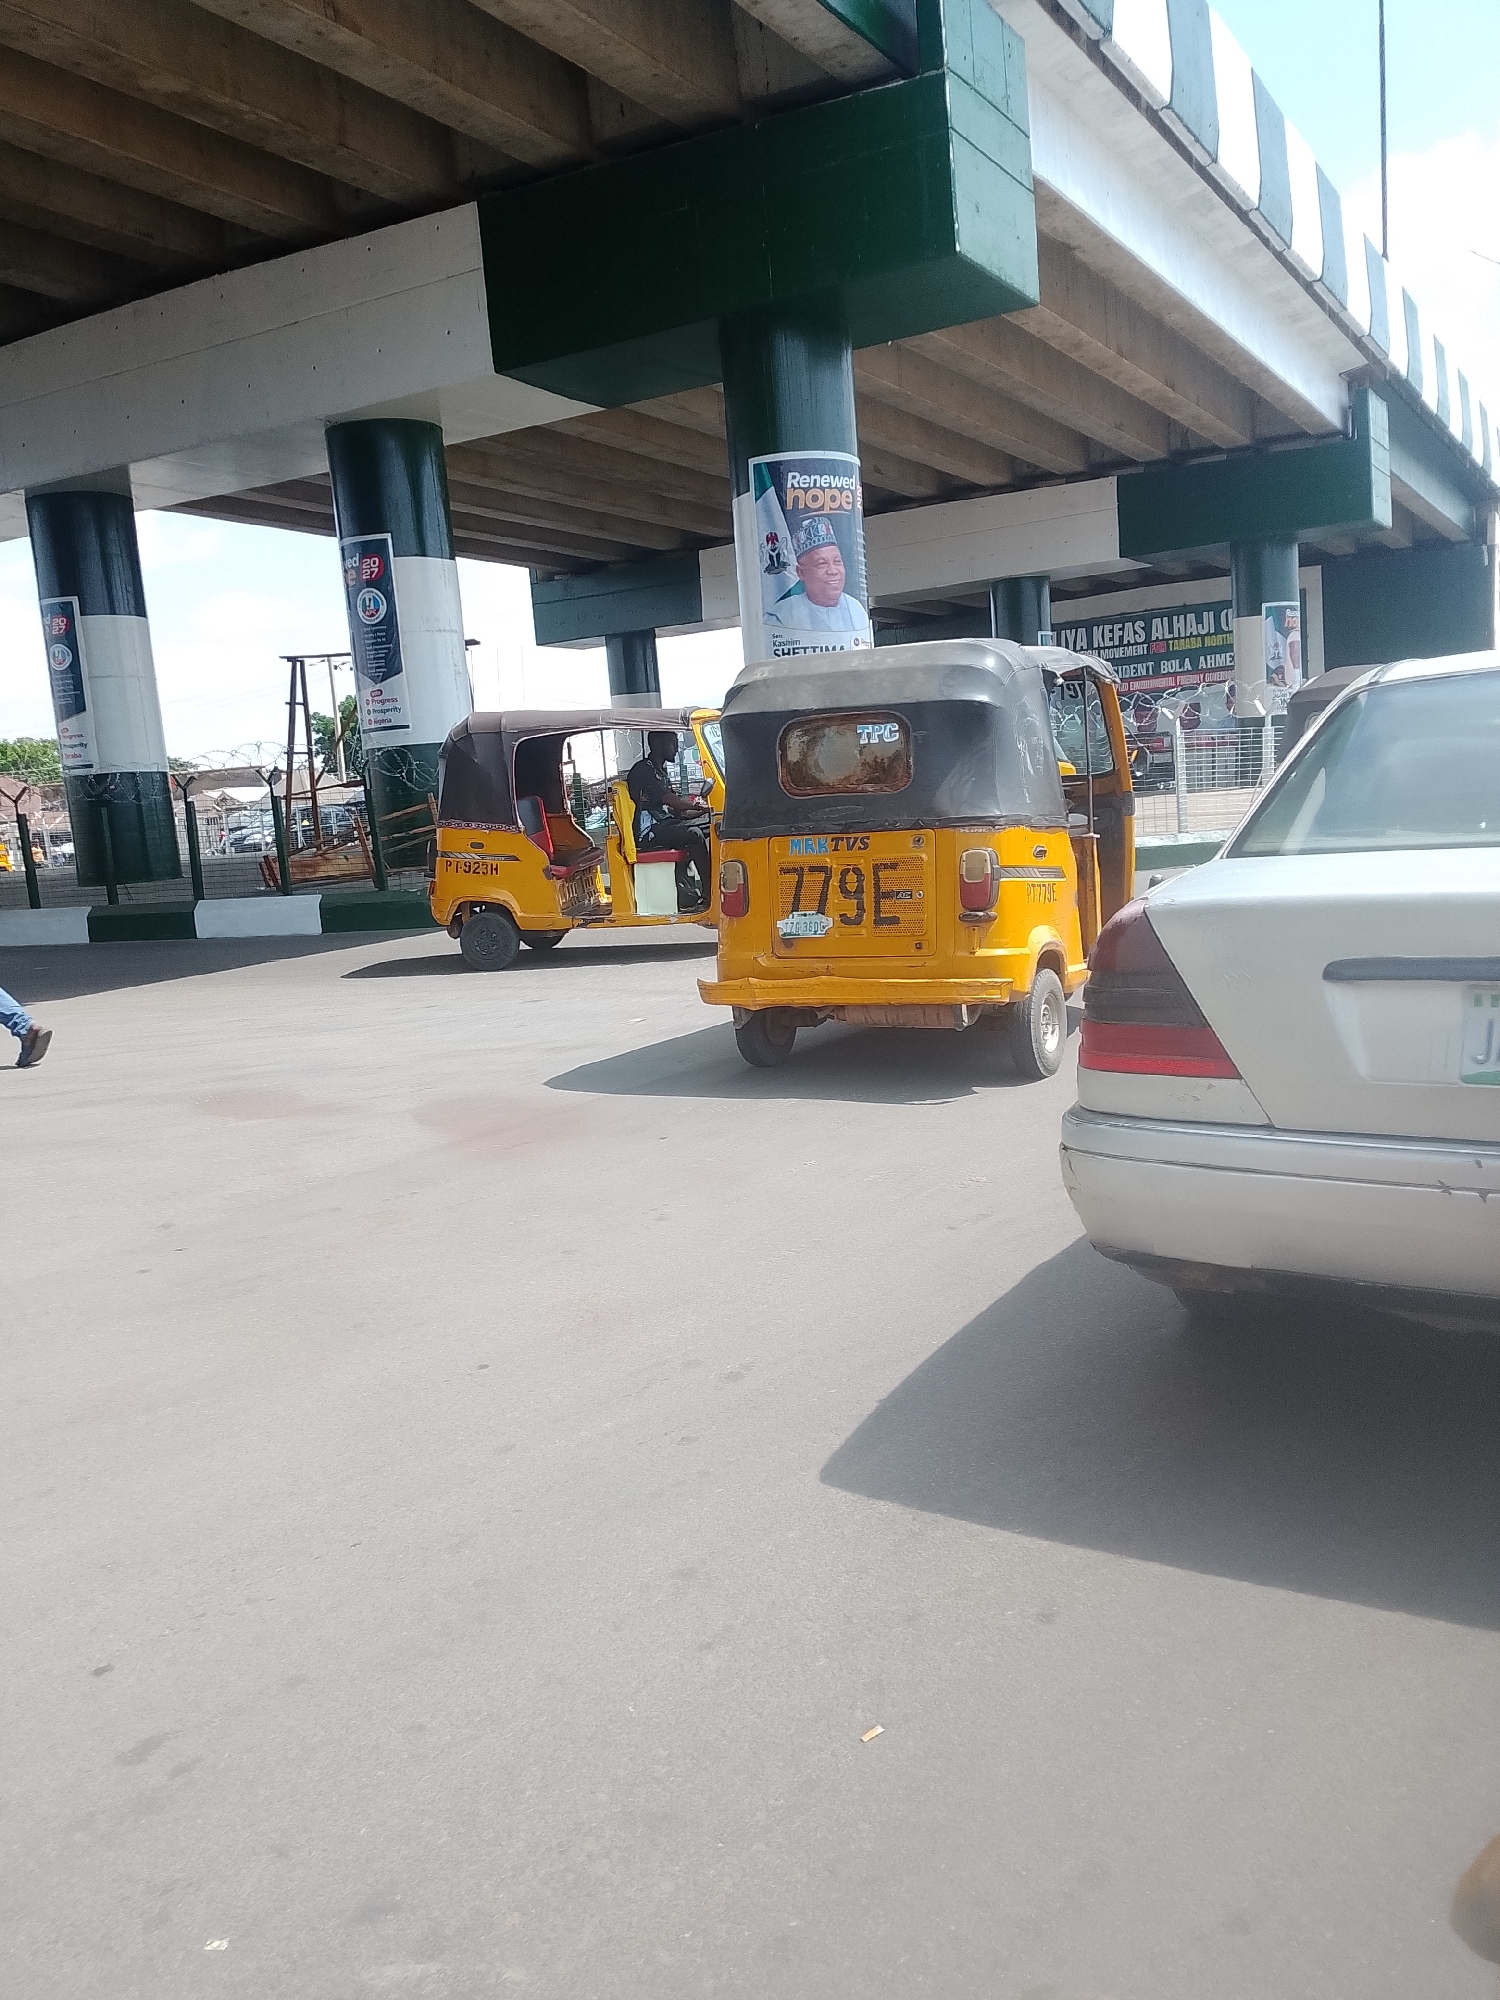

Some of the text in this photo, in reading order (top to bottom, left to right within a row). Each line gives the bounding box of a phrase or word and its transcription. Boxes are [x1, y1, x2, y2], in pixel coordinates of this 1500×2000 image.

[786, 471, 856, 490] Renewed
[362, 557, 380, 569] 20
[362, 567, 379, 580] 27
[52, 617, 67, 626] 20
[52, 625, 66, 635] 27
[1092, 620, 1146, 649] KEFAS
[1151, 610, 1216, 641] ALHAJI
[772, 638, 801, 648] Kashim
[1101, 643, 1148, 660] MOVEMENT
[1160, 657, 1192, 674] BOLA
[371, 697, 399, 706] Progress
[372, 705, 402, 715] Prosperity
[856, 722, 900, 745] TPC
[830, 835, 871, 852] TVS
[779, 862, 901, 927] 779E
